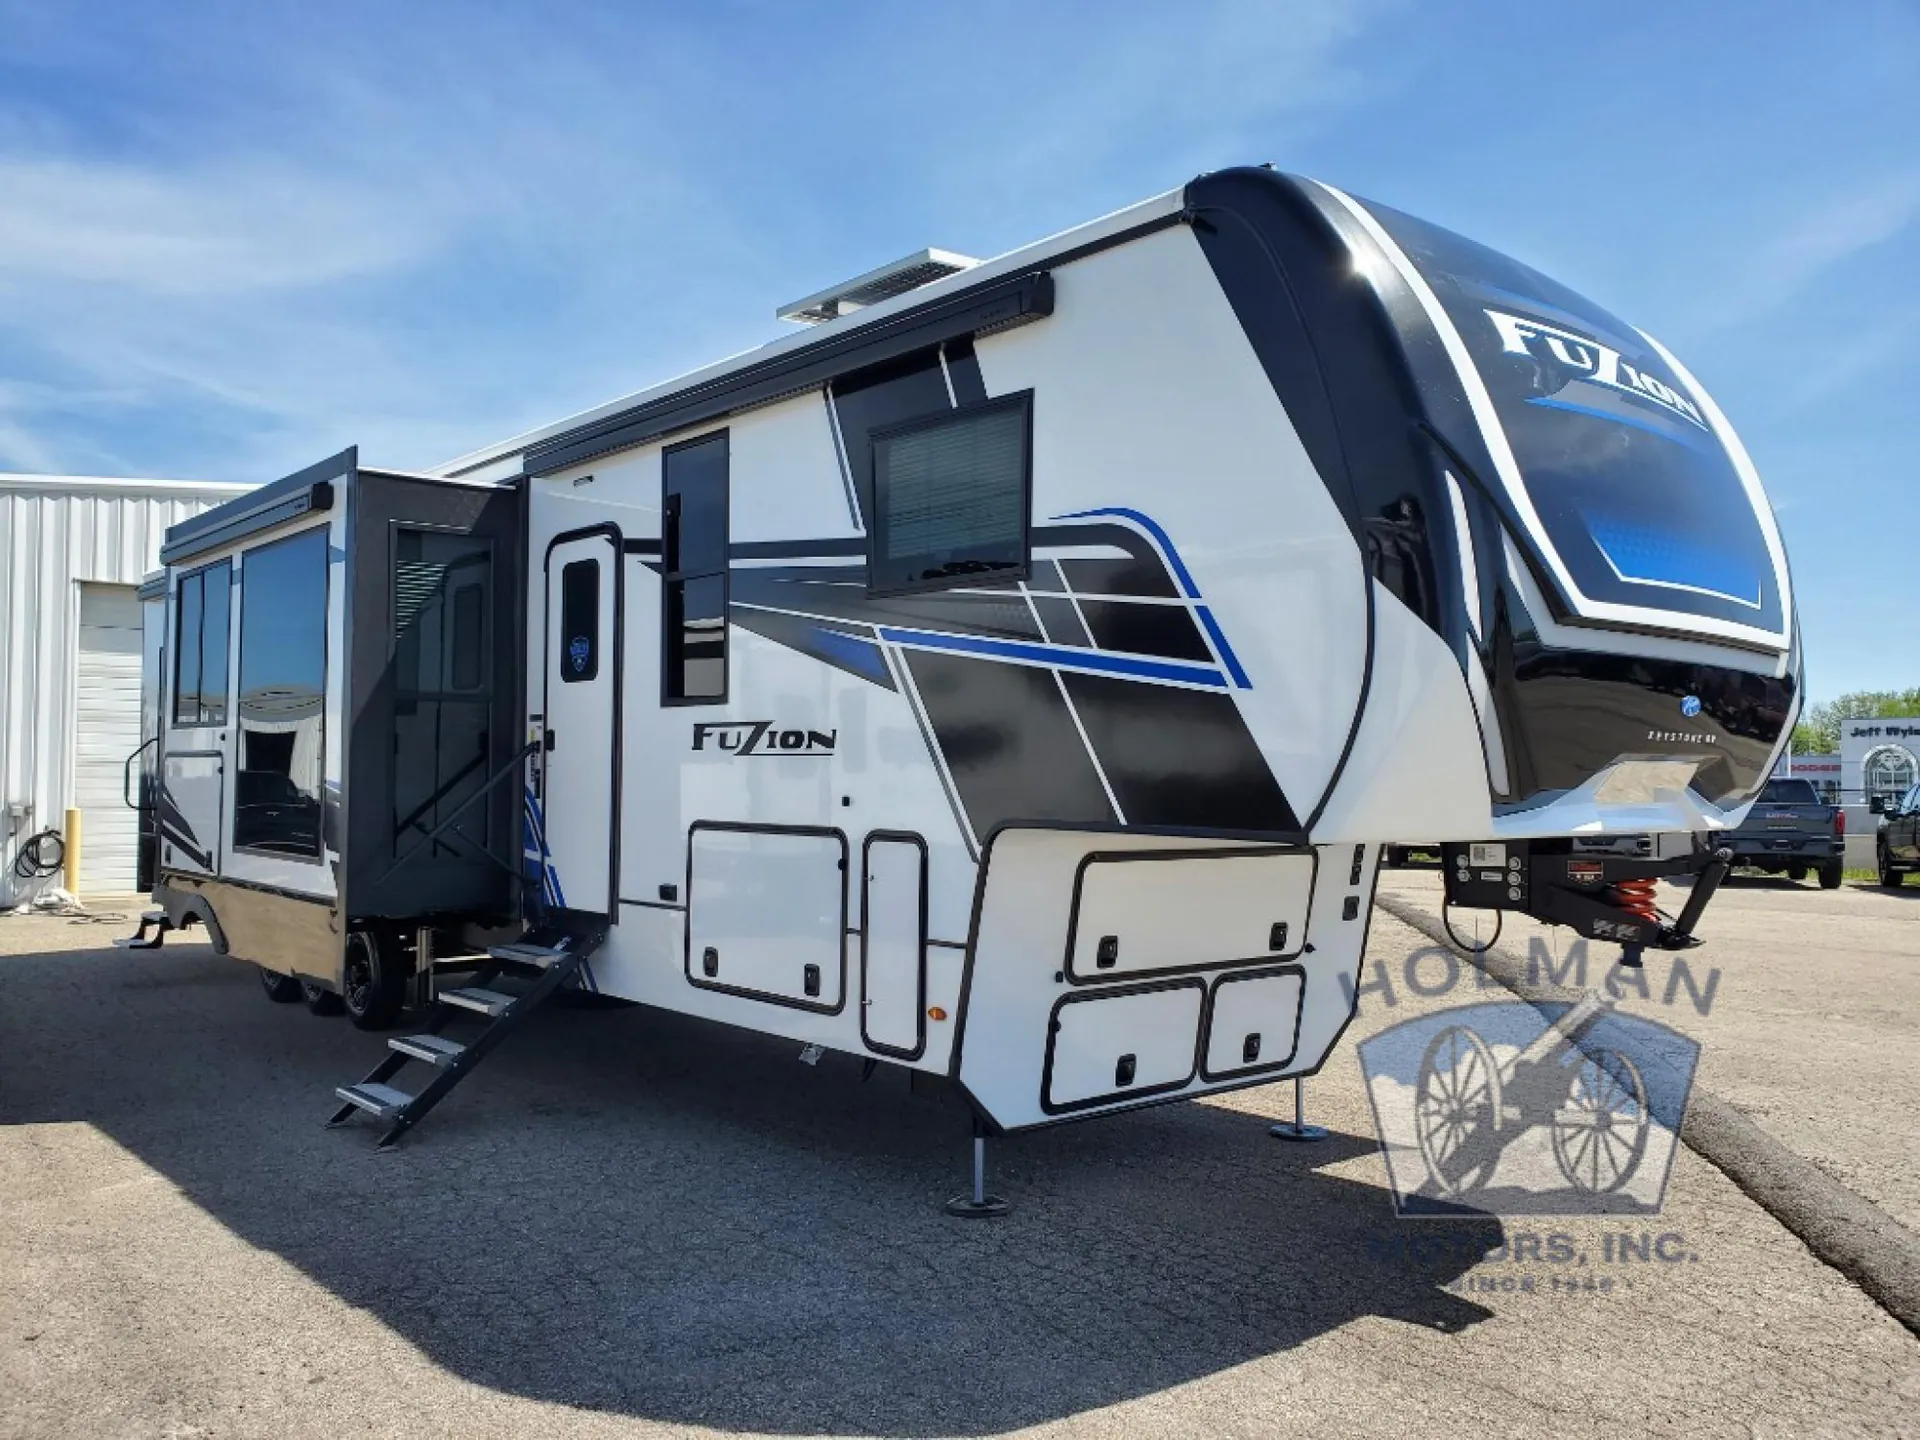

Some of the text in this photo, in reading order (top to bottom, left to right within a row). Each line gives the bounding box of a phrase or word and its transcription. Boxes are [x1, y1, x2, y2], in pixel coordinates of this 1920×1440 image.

[1483, 308, 1709, 432] FUZION
[691, 720, 837, 756] FUZION
[1851, 726, 1881, 738] Jeff
